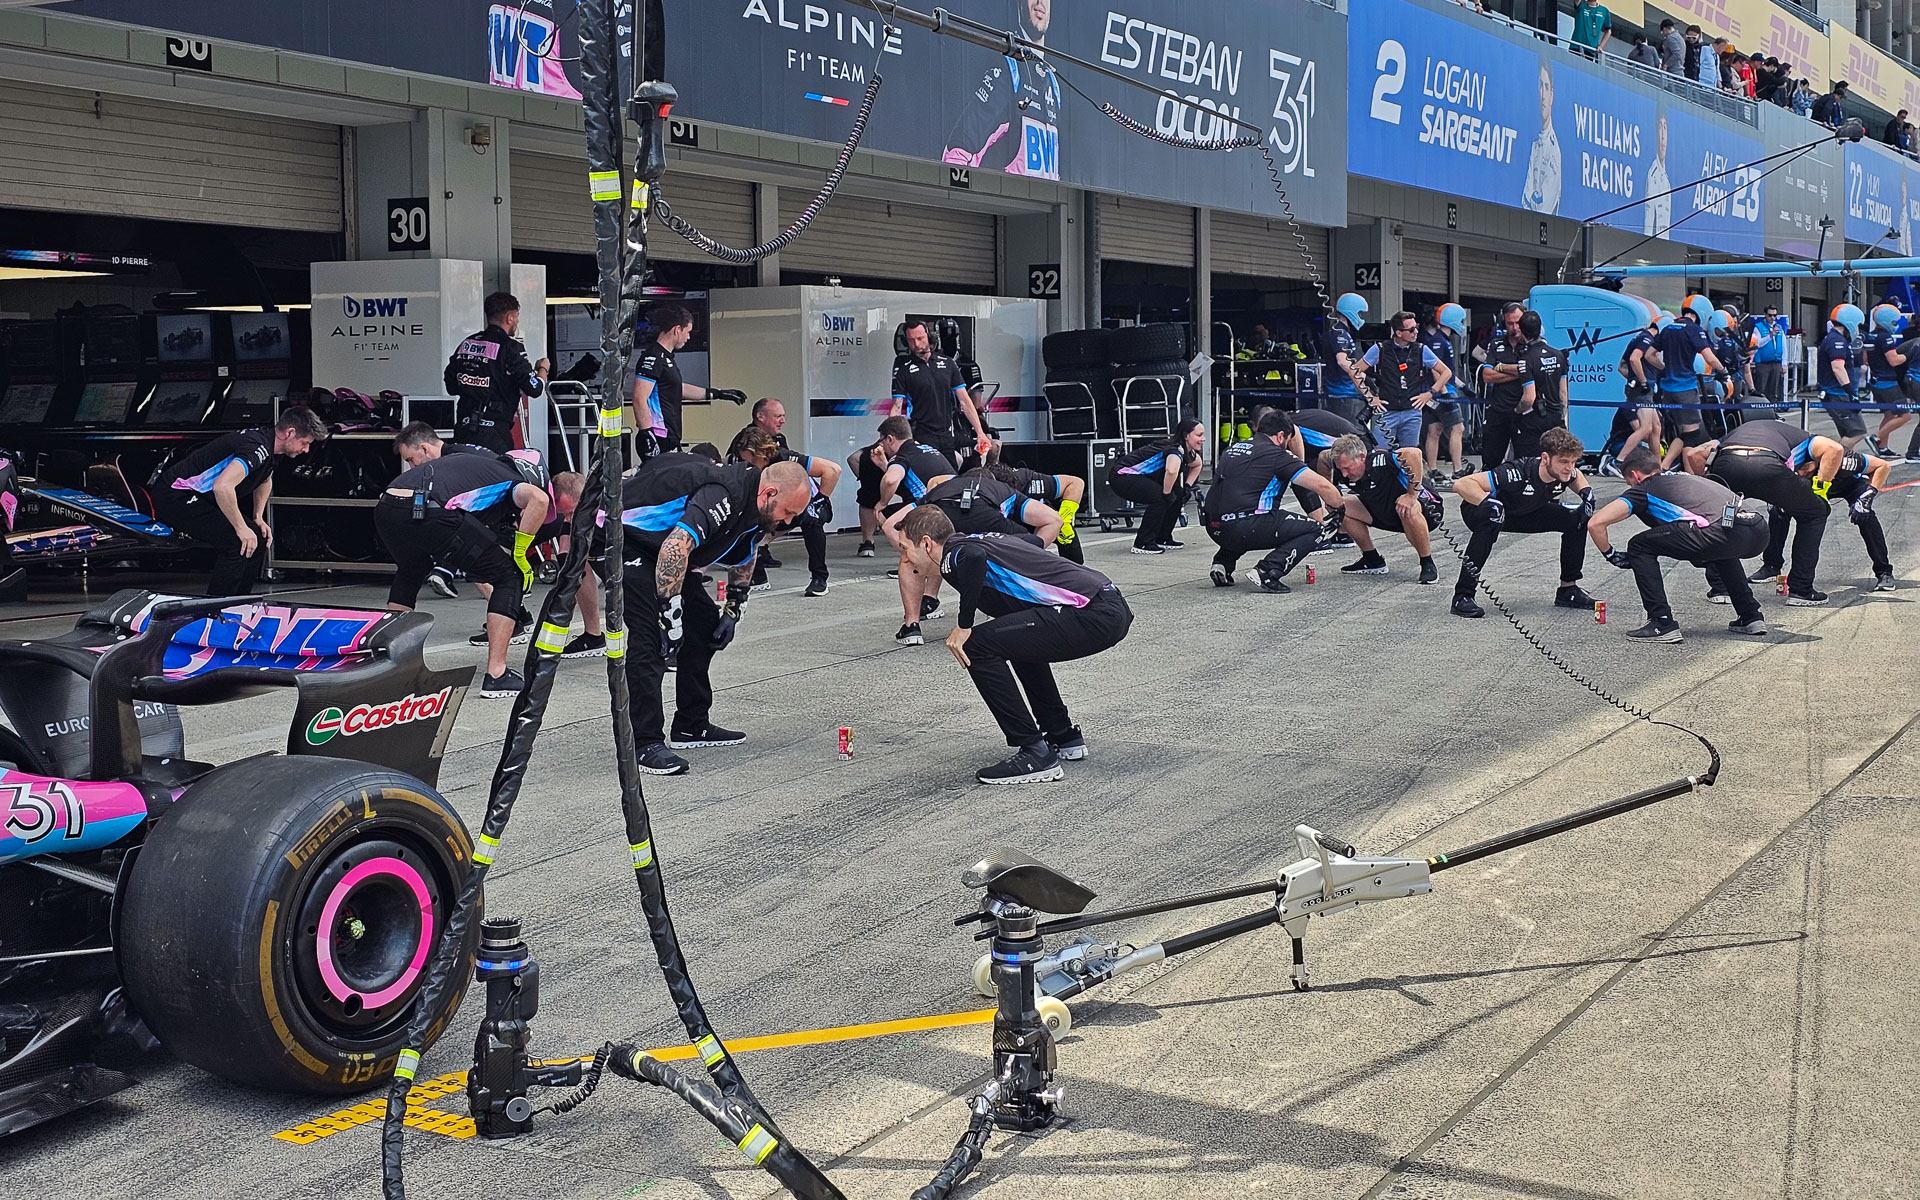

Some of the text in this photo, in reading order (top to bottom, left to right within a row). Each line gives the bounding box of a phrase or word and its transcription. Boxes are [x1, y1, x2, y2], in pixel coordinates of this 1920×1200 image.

[743, 0, 903, 55] ALPINE
[488, 13, 548, 85] WT
[1101, 11, 1243, 96] ESTEBAN
[1769, 13, 1812, 78] DHL
[818, 56, 865, 84] TEAM
[1370, 39, 1406, 125] 2
[1423, 56, 1487, 112] LOGAN
[1848, 43, 1881, 97] DHL
[1155, 89, 1241, 151] OCON
[1269, 49, 1316, 178] 31
[1419, 104, 1517, 164] SARGEANT
[1574, 103, 1641, 159] WILLIAMS
[1581, 151, 1633, 199] RACING
[1701, 150, 1729, 184] ALEX
[1692, 184, 1728, 218] ALBON
[1731, 163, 1763, 223] 23
[1849, 160, 1863, 219] 22
[1866, 172, 1880, 198] YUKI
[390, 206, 426, 244] 30
[1447, 207, 1456, 226] 35
[1865, 198, 1892, 228] TSUNODA
[111, 256, 149, 266] 10 PIERRE
[1030, 270, 1060, 296] 32
[1356, 267, 1380, 288] 34
[1767, 278, 1783, 291] 38
[363, 297, 408, 318] BWT
[832, 316, 855, 331] BWT
[331, 324, 424, 337] ALPINE
[371, 342, 399, 351] TEAM
[816, 336, 863, 346] ALPINE
[456, 353, 489, 364] ALPINE
[470, 343, 487, 354] BWT
[461, 374, 490, 387] Castrol
[1567, 363, 1613, 374] ILLIAMS
[1569, 374, 1607, 384] ACING
[51, 503, 87, 524] INFINOX
[342, 687, 452, 735] Castrol
[0, 781, 86, 844] 31
[285, 799, 353, 871] PIRELLI
[294, 1129, 316, 1138] 20
